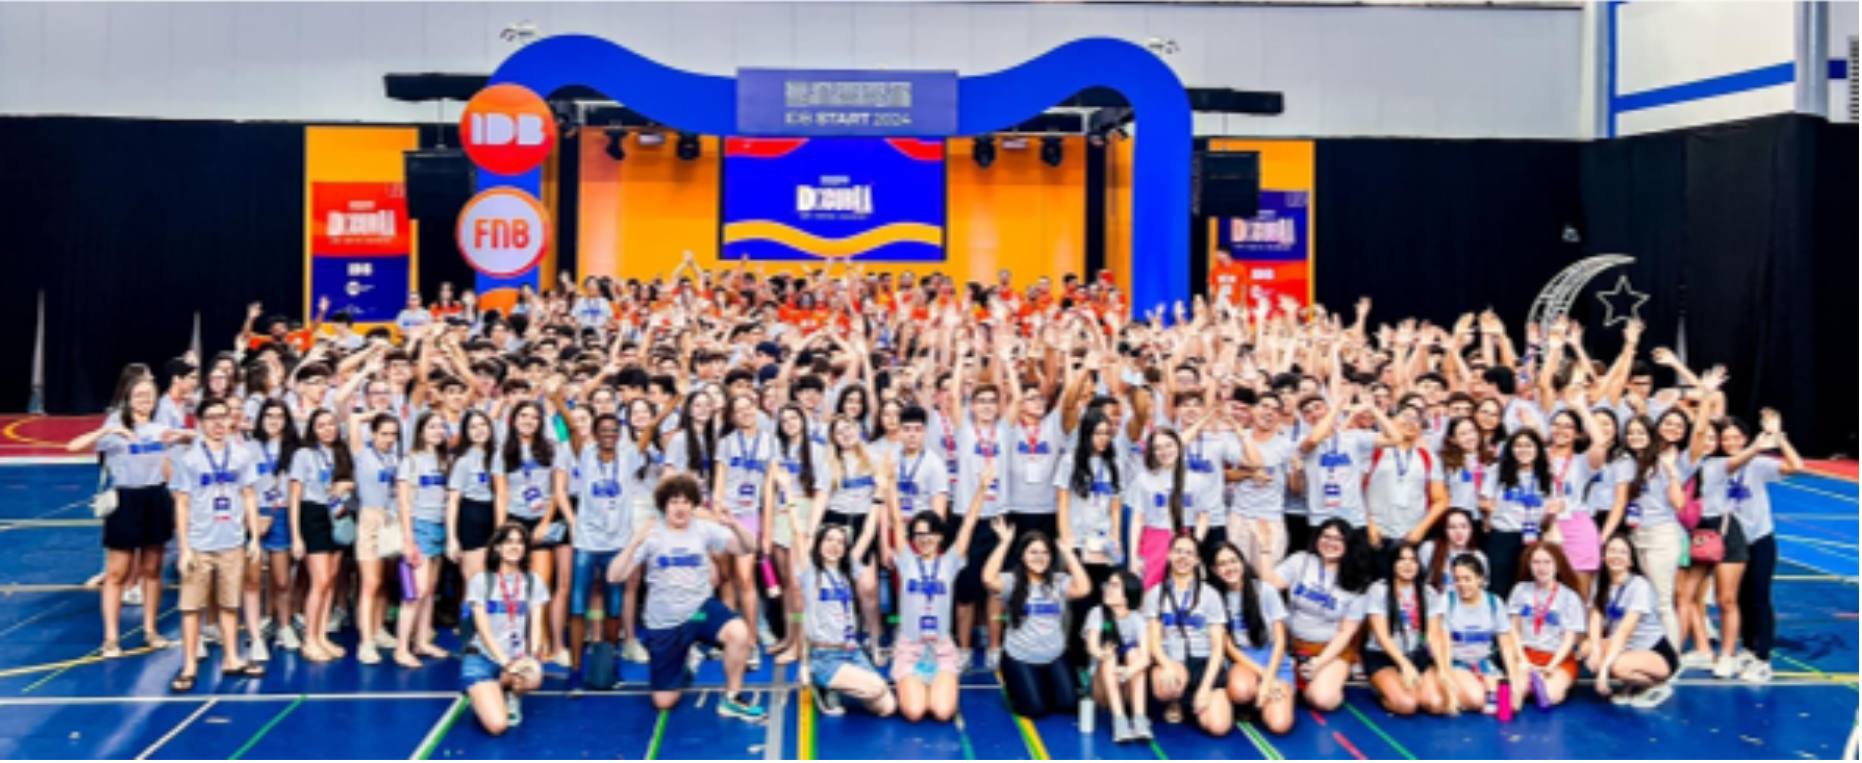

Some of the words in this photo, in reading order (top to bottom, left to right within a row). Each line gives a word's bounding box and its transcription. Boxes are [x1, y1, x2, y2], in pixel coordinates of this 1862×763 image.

[471, 112, 546, 146] IDB
[815, 112, 870, 124] START
[474, 218, 531, 250] FNB
